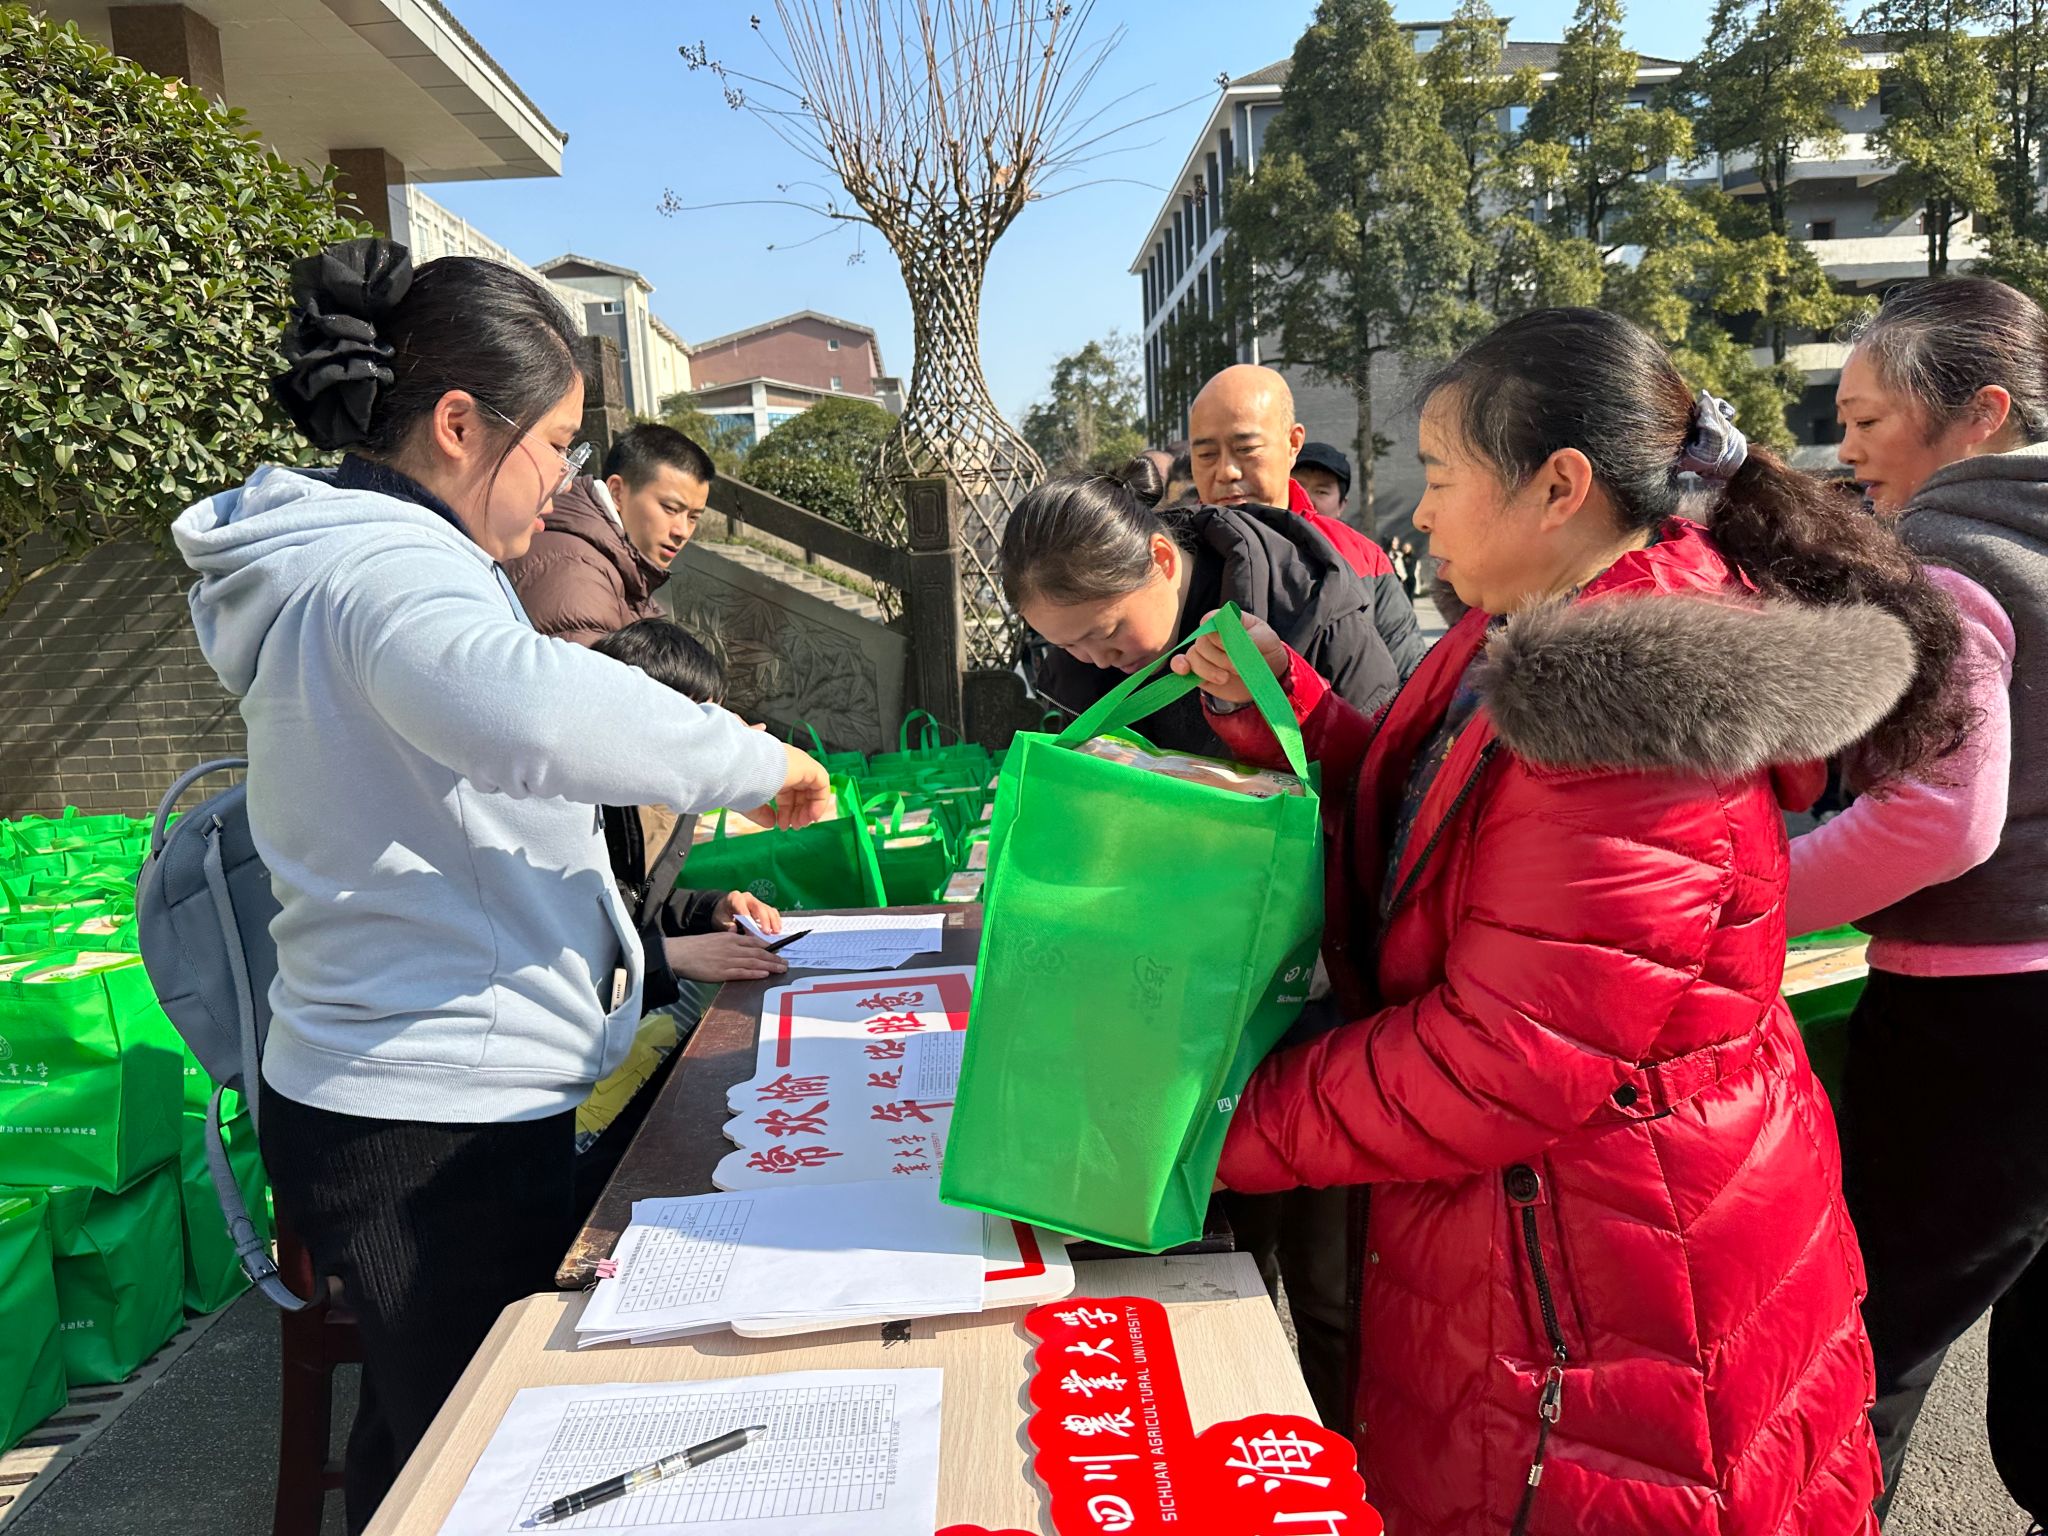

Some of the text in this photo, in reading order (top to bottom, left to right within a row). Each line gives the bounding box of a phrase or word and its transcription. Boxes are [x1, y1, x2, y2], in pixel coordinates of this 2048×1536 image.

[1126, 1305, 1178, 1522] SICHUAN AGRICULTURAL UNIVERSITY
